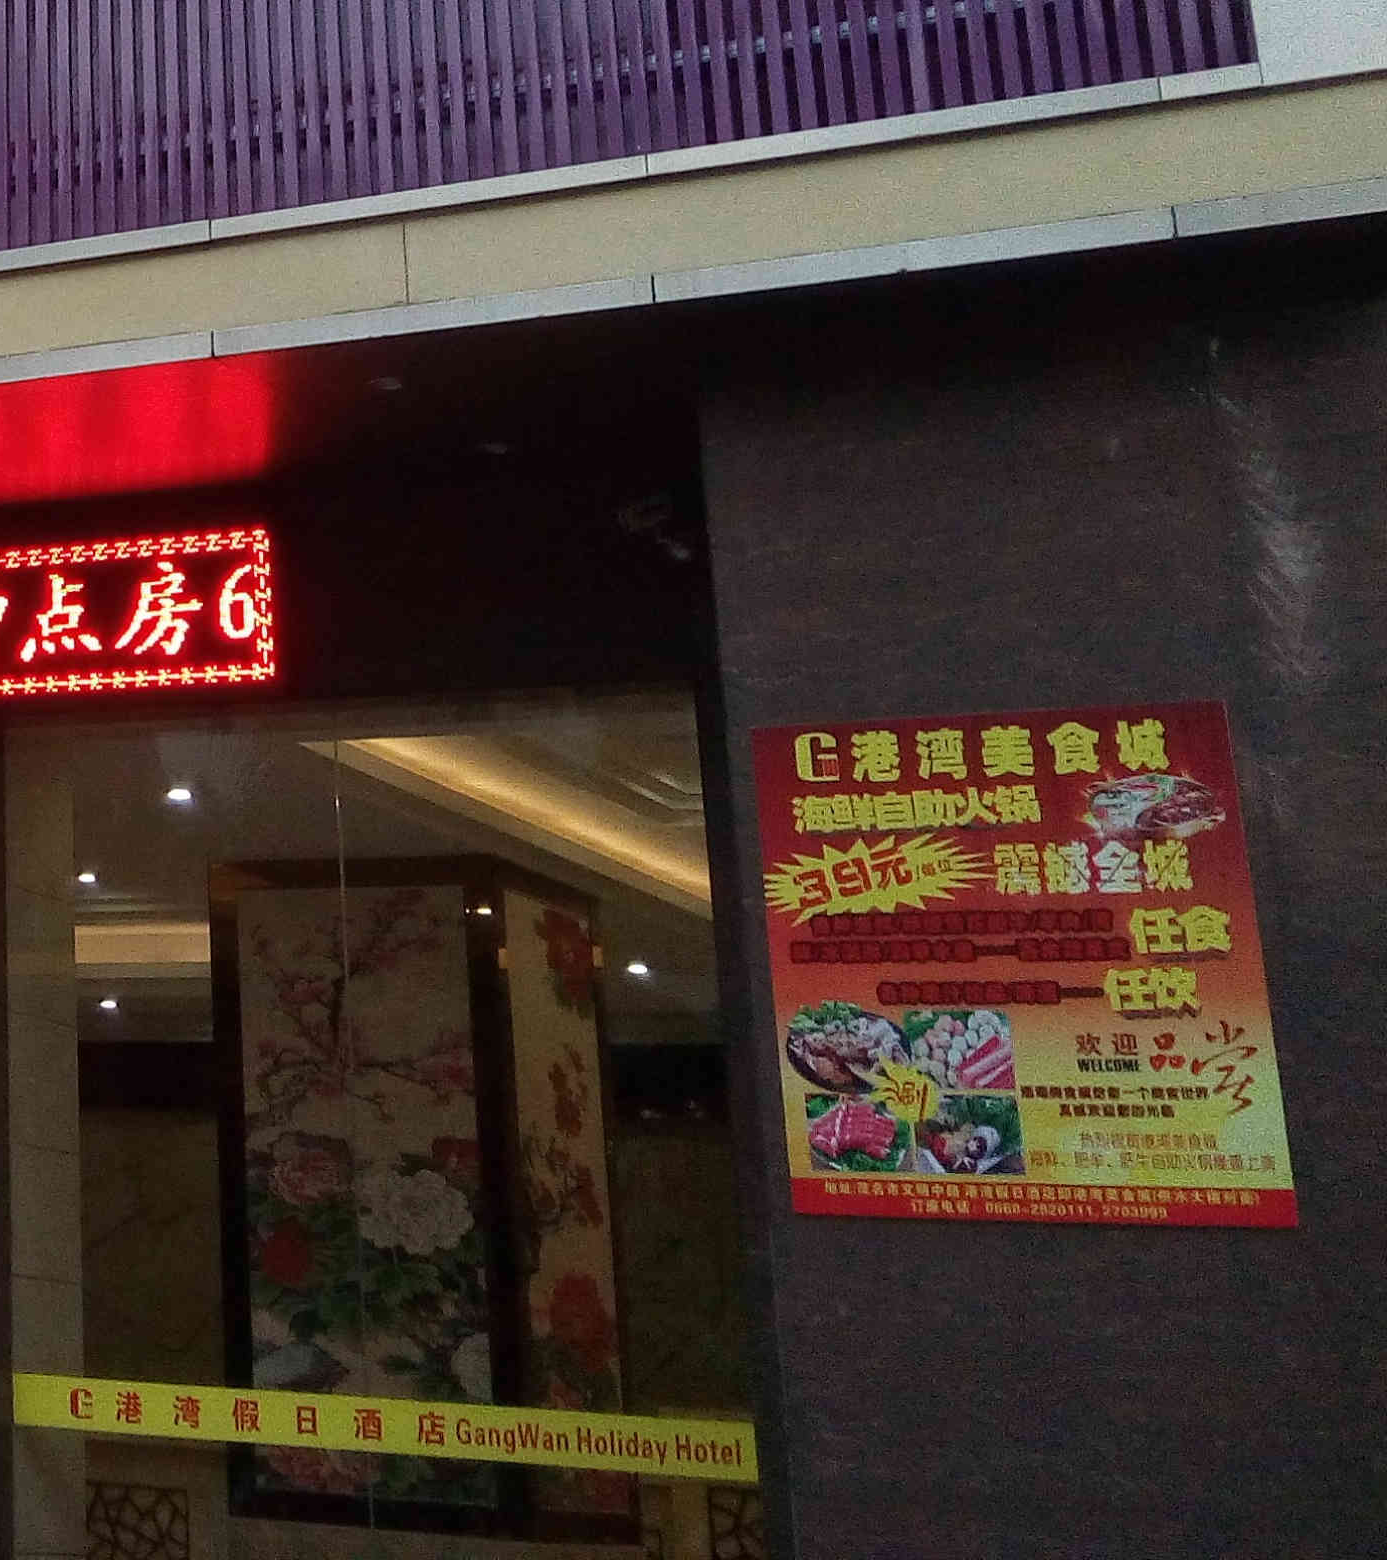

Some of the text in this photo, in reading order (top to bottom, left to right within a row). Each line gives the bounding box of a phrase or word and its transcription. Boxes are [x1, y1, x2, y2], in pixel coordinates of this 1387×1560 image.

[850, 718, 1170, 783] 港湾美食城
[792, 784, 1043, 834] 海鲜自助火锅
[993, 839, 1194, 896] 震撼全城
[1129, 904, 1232, 956] 任食
[1103, 966, 1200, 1012] 任饮
[1075, 1032, 1139, 1056] 欢迎
[116, 1391, 445, 1446] 港湾假日酒店
[575, 1425, 668, 1466] Holiday
[673, 1433, 743, 1466] Hotel
